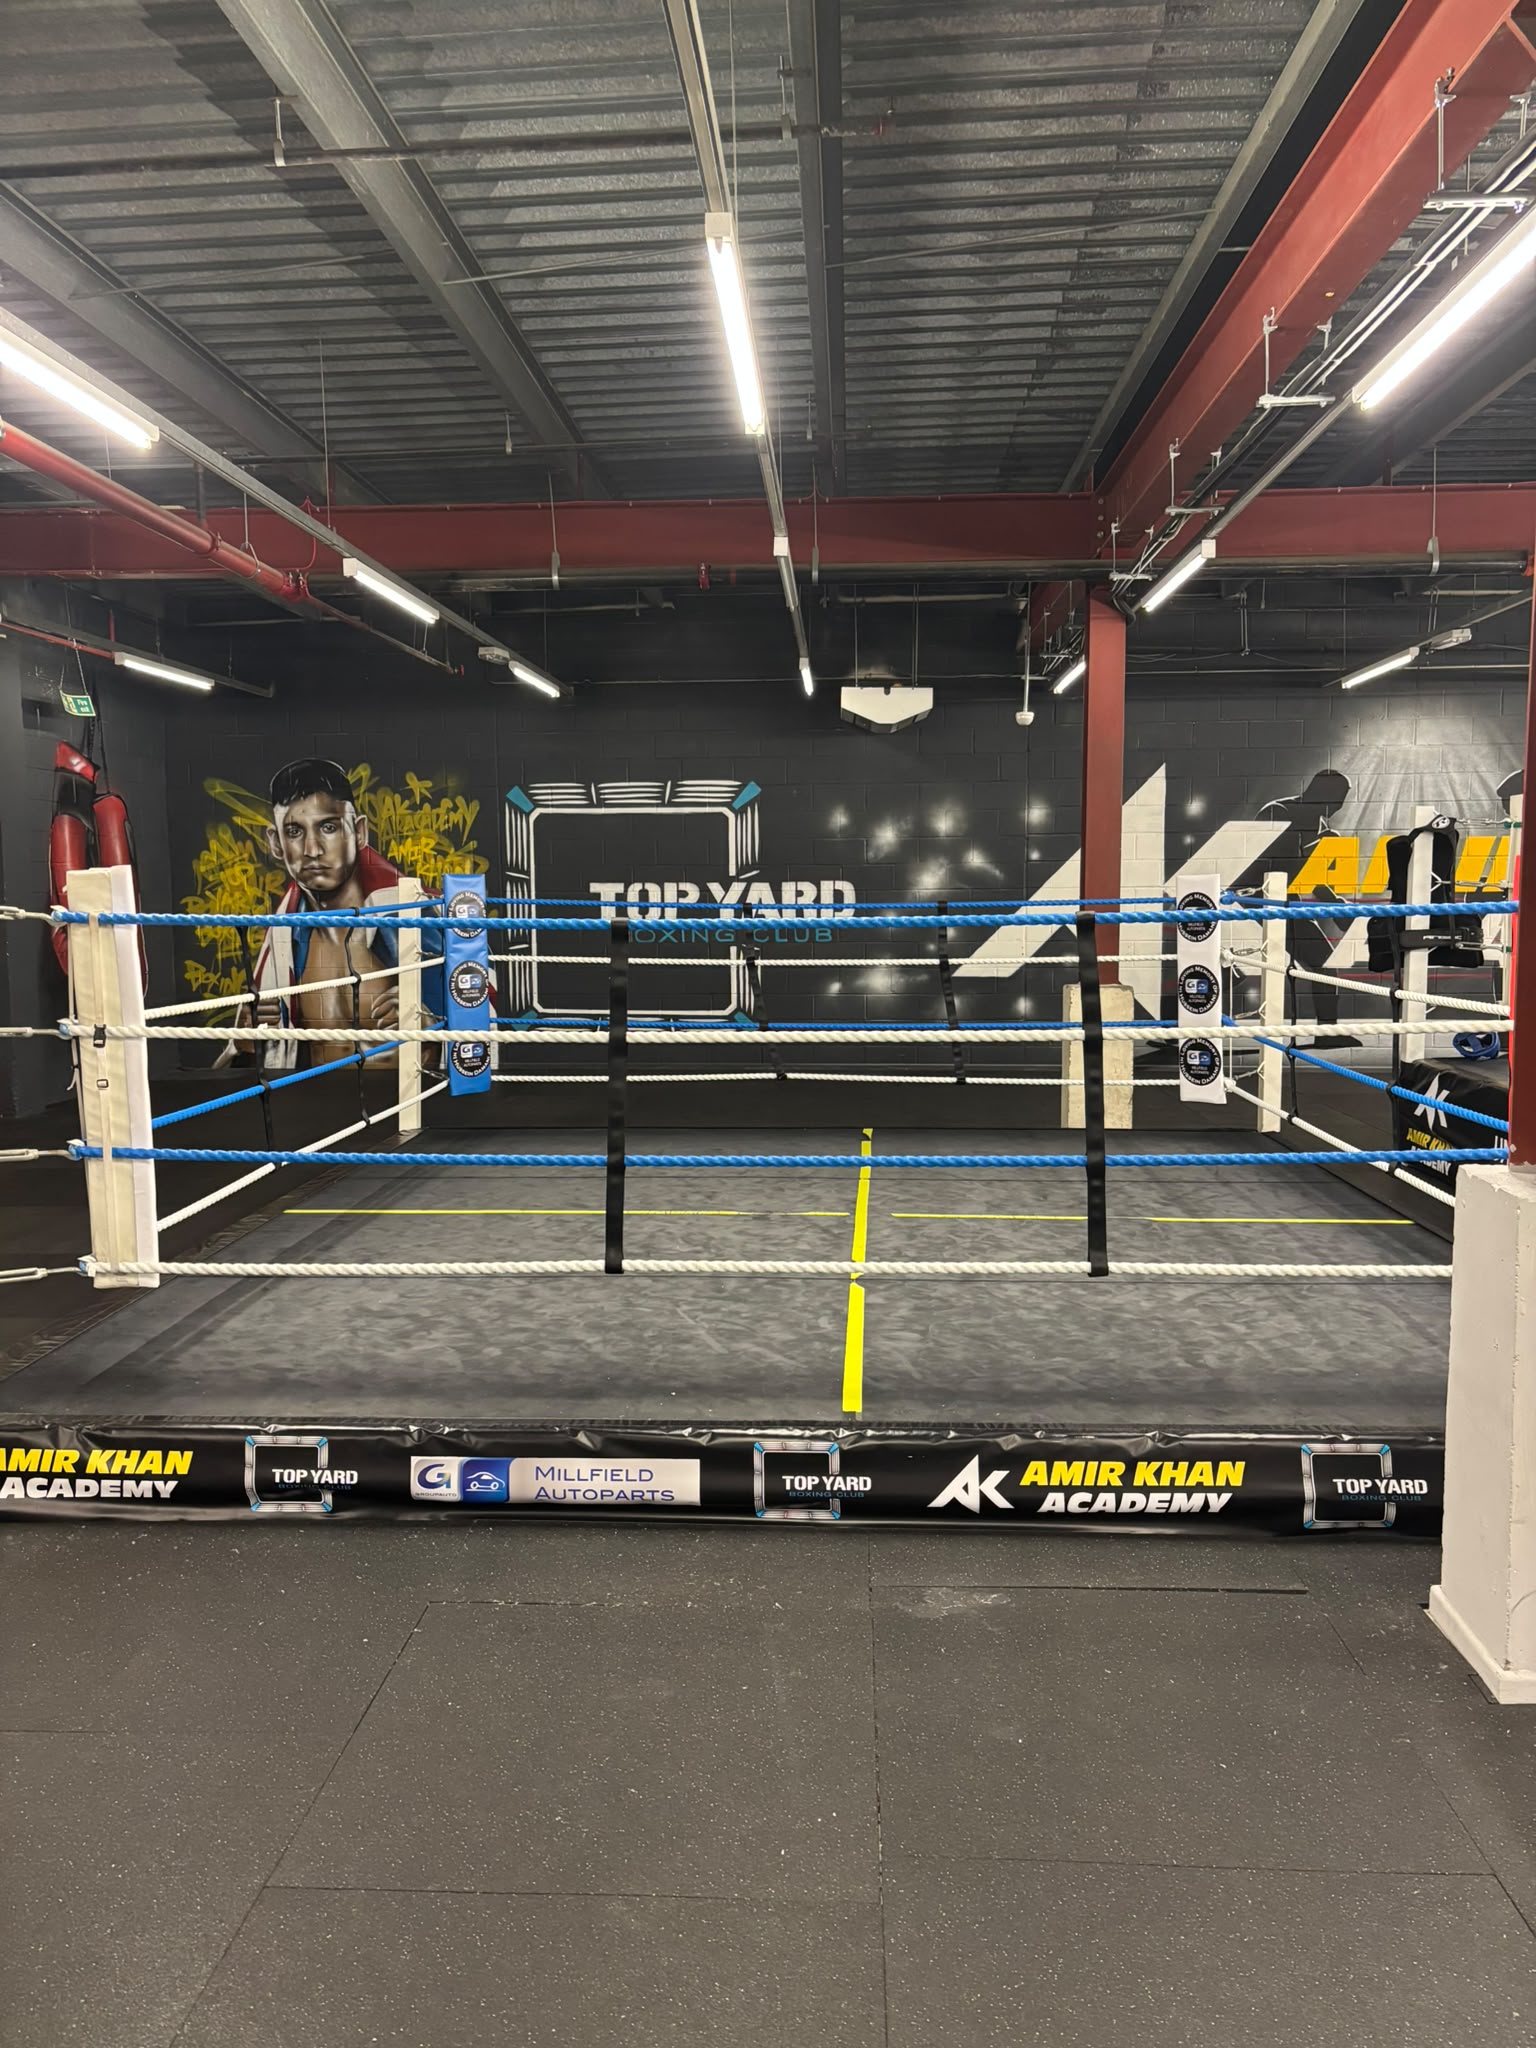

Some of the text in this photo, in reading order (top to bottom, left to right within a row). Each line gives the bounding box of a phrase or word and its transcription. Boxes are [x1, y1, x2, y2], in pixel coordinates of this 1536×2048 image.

[589, 880, 857, 919] TOP YARD
[628, 928, 833, 942] OXING CLUB
[0, 1447, 194, 1475] MIR KHAN
[271, 1468, 359, 1485] TOP YARD
[535, 1466, 654, 1482] MILLFIELD
[1019, 1461, 1245, 1487] AMIR KHAN
[0, 1477, 180, 1499] ACADEMY
[782, 1475, 872, 1491] TOP YARD
[1332, 1479, 1428, 1494] TOP YARD
[535, 1487, 675, 1501] AUTOPARTS
[1037, 1492, 1233, 1514] ACADEMY
